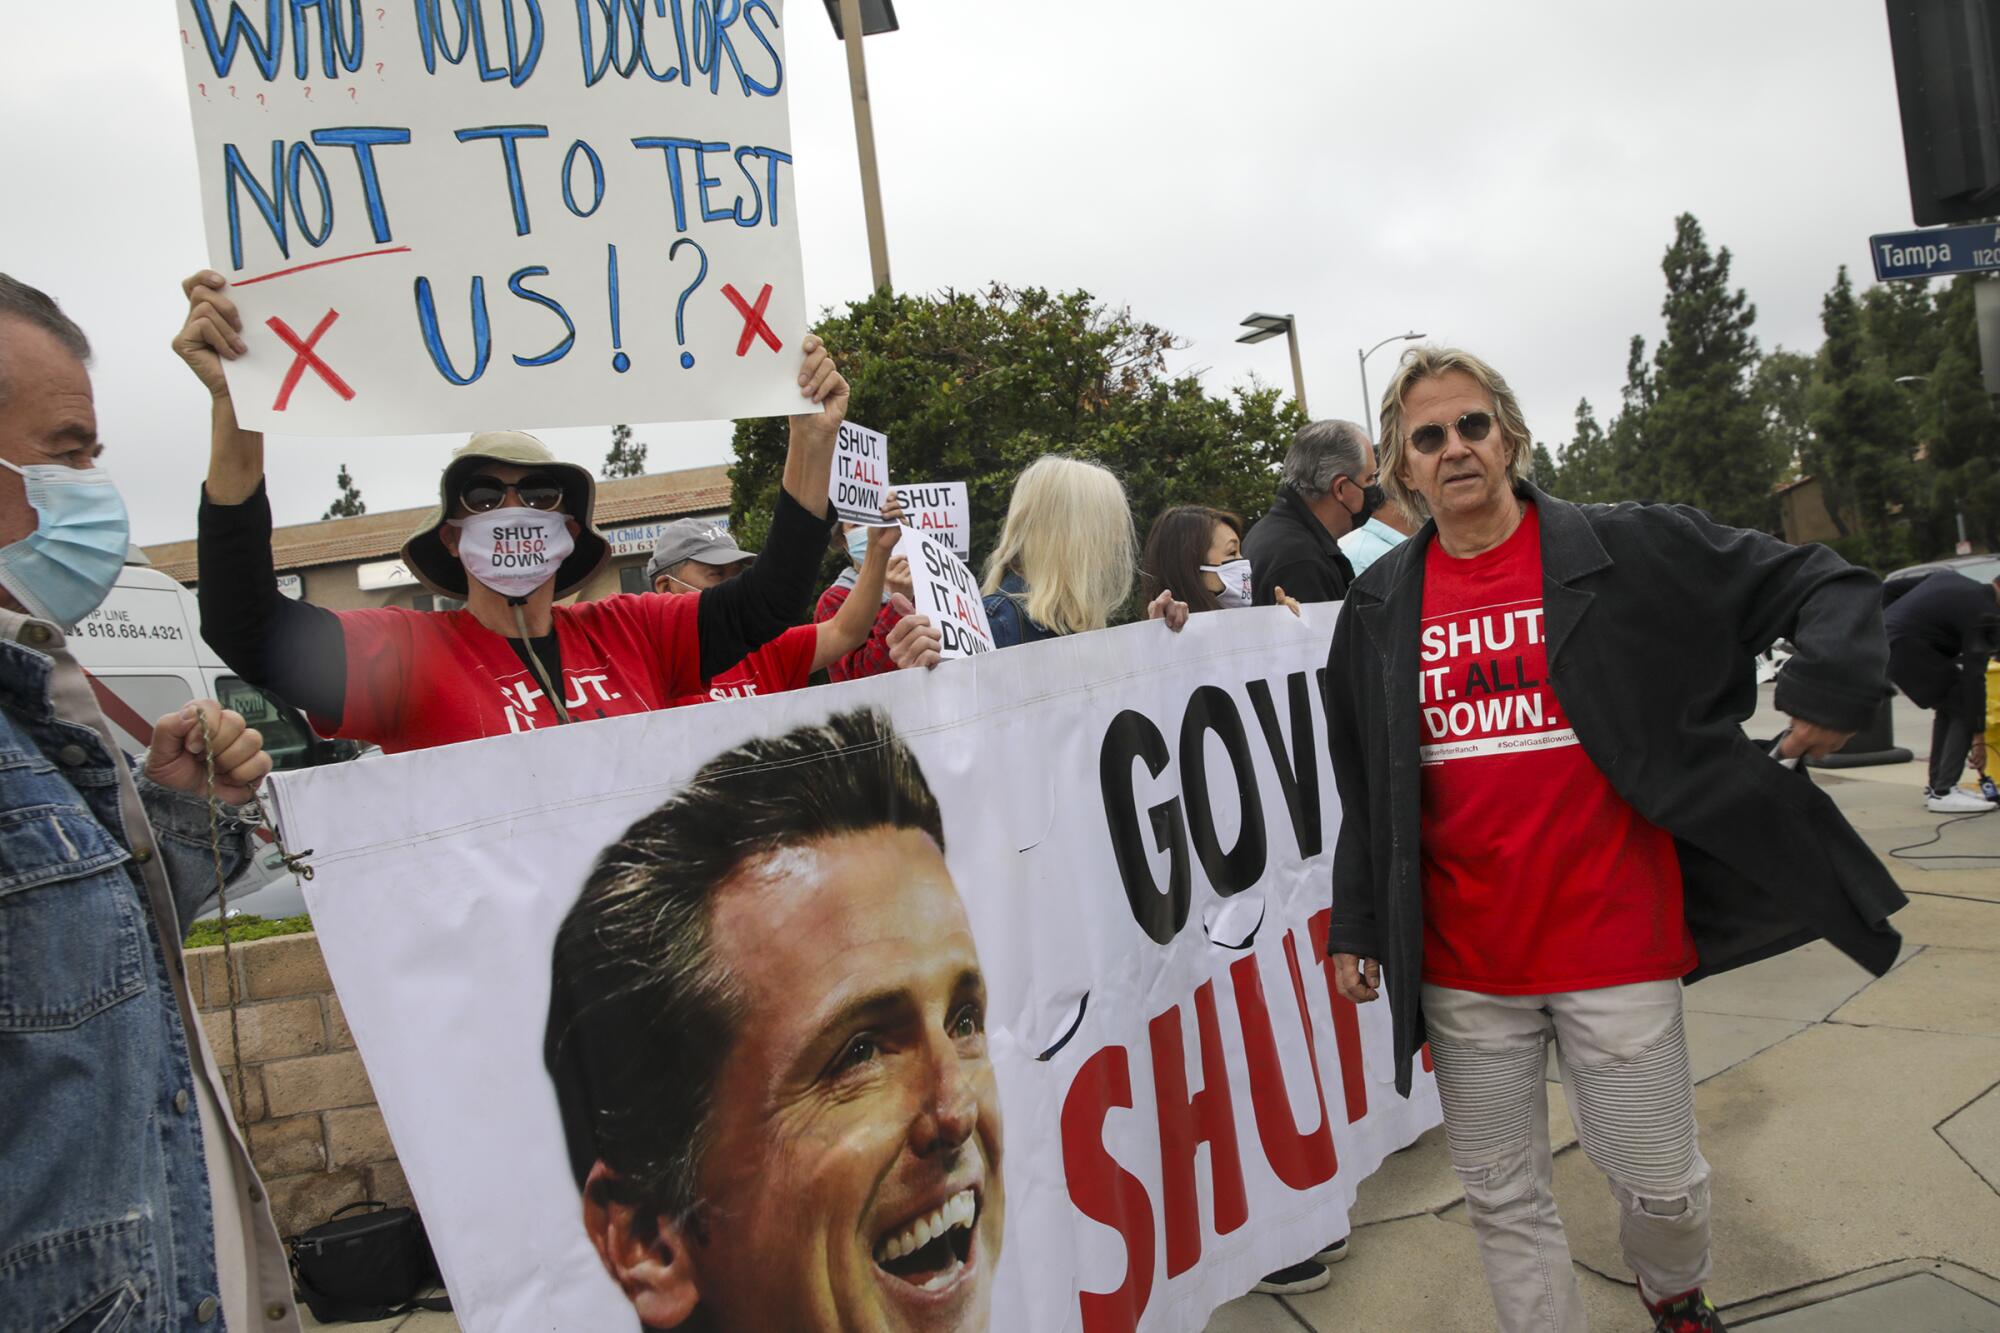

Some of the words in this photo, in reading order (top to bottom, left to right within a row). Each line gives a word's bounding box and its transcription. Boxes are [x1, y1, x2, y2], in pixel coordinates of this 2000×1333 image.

[224, 127, 411, 271] NOT
[454, 125, 605, 237] TO
[631, 137, 792, 232] TEST
[1881, 243, 1951, 269] Tampa
[838, 425, 880, 461] SHUT.
[838, 482, 882, 511] DOWN.
[896, 487, 956, 510] SHUT.
[492, 526, 548, 541] SHUT.
[617, 527, 643, 543] Child
[494, 540, 546, 554] ALISO.
[492, 553, 549, 568] DOWN.
[104, 610, 130, 621] LINE
[87, 622, 183, 640] 818.684.4321
[1421, 608, 1545, 662] SHUT.
[1420, 667, 1456, 703] IT.
[1424, 693, 1557, 739] DOWN.
[1100, 668, 1329, 944] GOV
